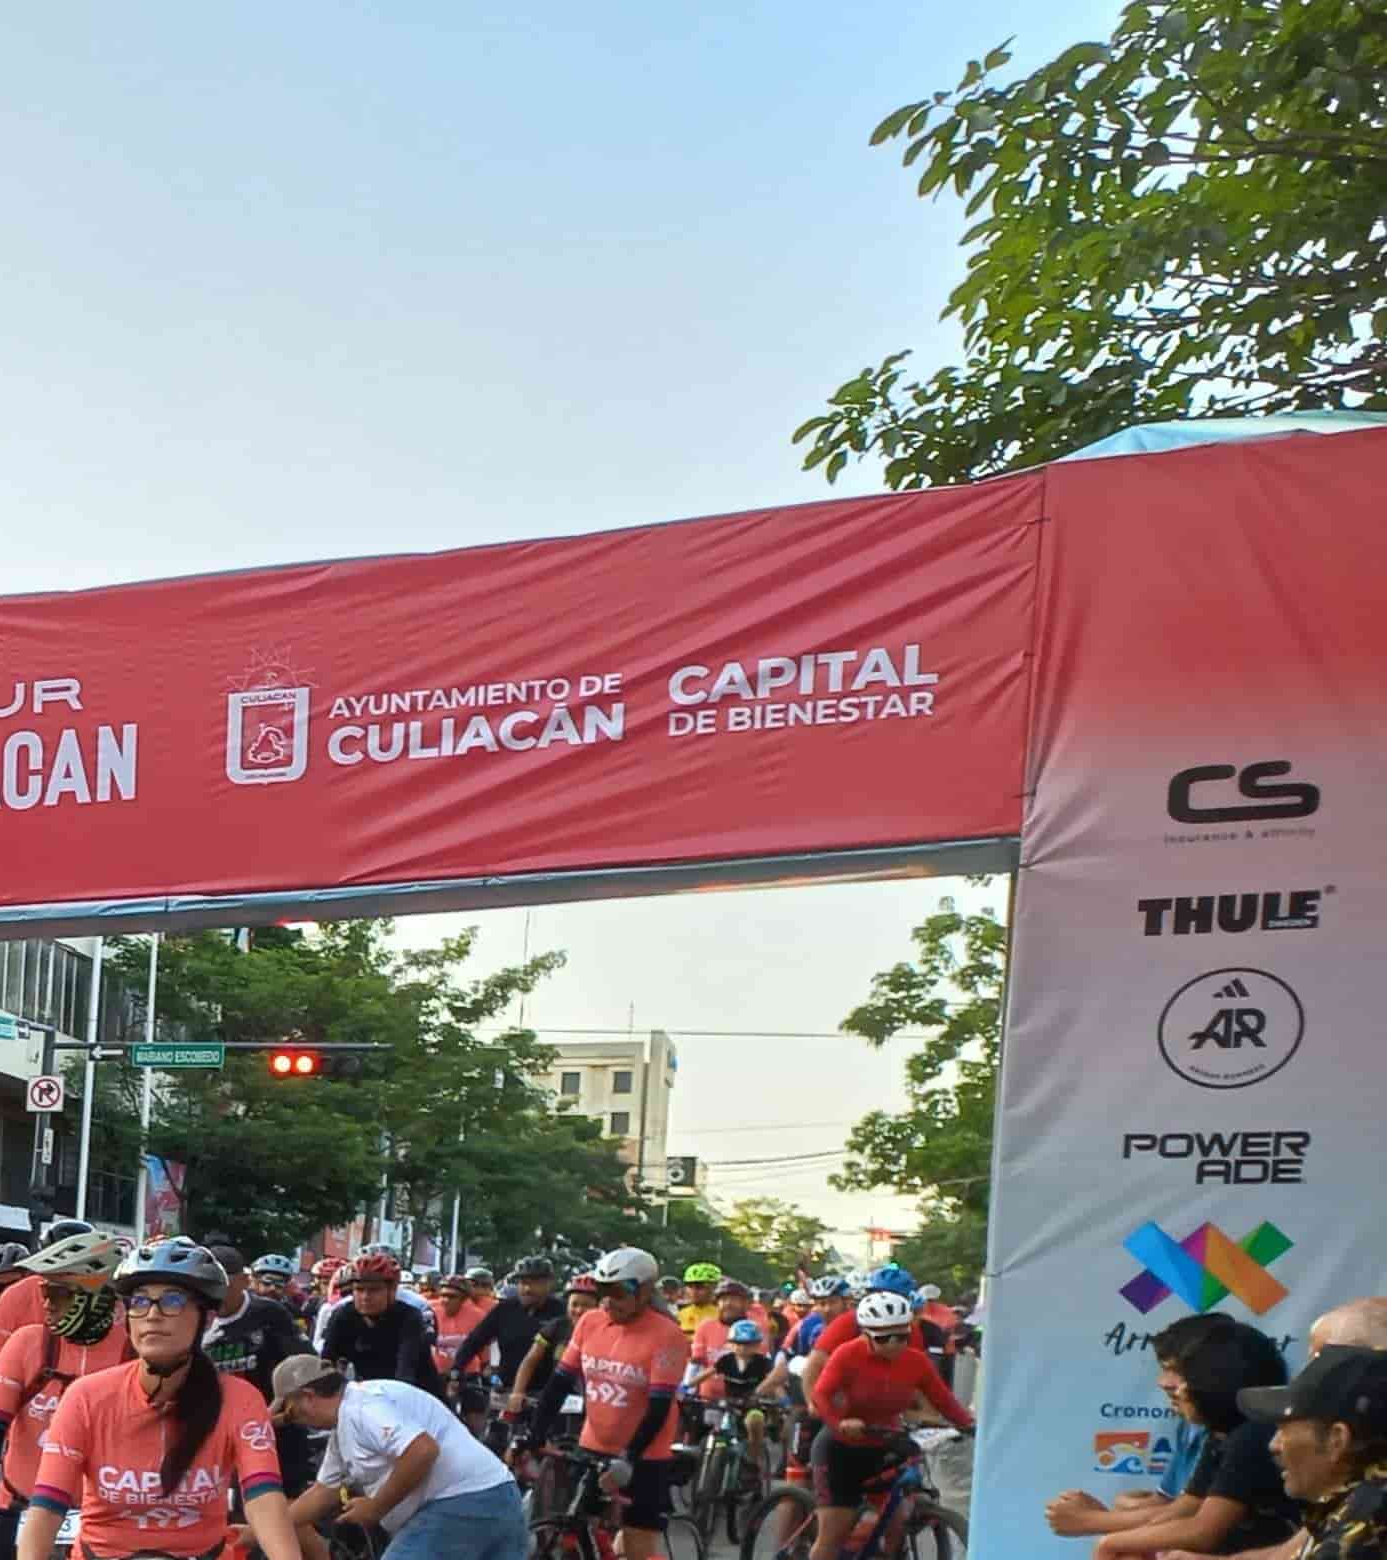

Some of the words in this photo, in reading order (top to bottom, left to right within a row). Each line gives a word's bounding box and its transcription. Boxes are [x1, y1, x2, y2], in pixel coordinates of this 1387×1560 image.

[329, 680, 578, 718] AYUNTAMIENTO
[582, 673, 623, 696] DE
[668, 644, 939, 705] CAPITAL
[329, 702, 626, 766] CULIACÁN
[669, 710, 718, 737] DE
[727, 692, 935, 732] BIENESTAR
[1167, 760, 1321, 825] CS
[1138, 890, 1322, 936] THULE
[1123, 1131, 1311, 1158] POWER
[1195, 1159, 1305, 1185] ADE
